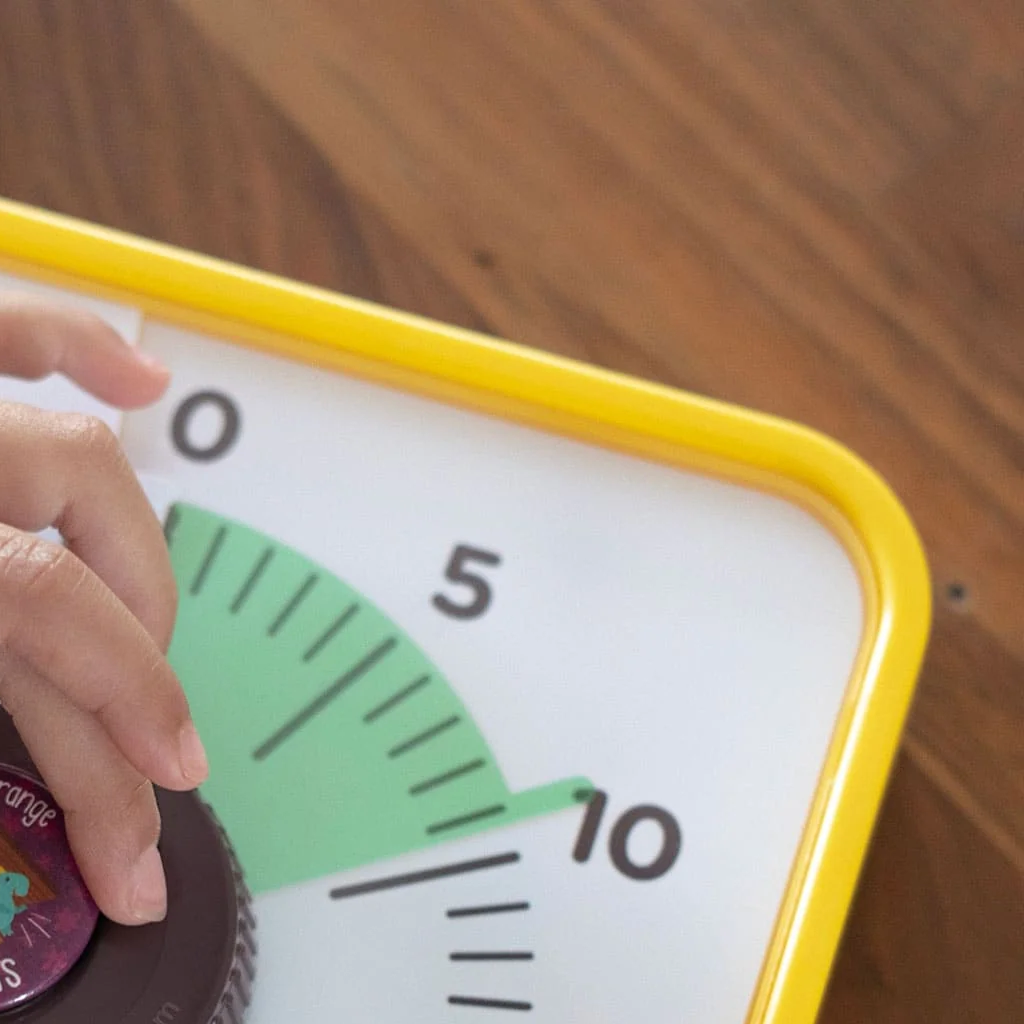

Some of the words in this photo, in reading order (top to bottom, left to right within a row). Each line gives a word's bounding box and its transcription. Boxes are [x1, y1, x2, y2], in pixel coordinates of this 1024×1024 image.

[170, 390, 241, 463] 0
[432, 544, 501, 620] 5
[571, 787, 683, 882] 10
